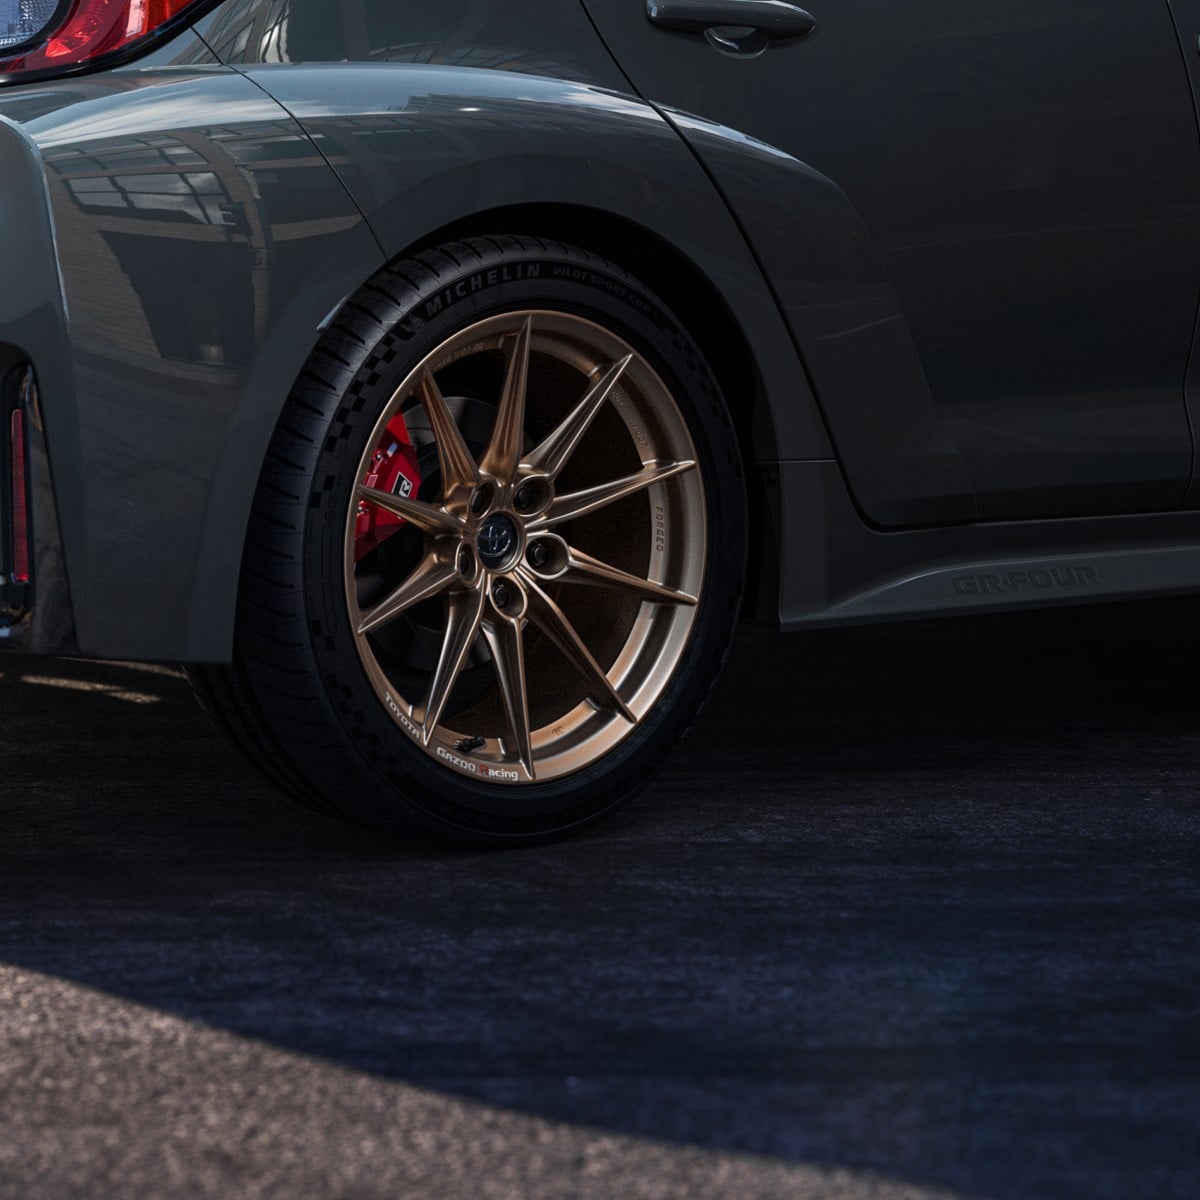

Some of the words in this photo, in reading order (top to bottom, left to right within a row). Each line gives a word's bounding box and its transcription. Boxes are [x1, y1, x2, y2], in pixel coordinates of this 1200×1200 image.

[425, 262, 541, 315] MICHELIN
[553, 265, 588, 280] PILOT
[591, 273, 626, 297] SPORT
[655, 505, 664, 552] FORGED
[384, 691, 420, 739] TOYOTA
[436, 746, 476, 772] GAZOO
[480, 764, 519, 781] Racing
